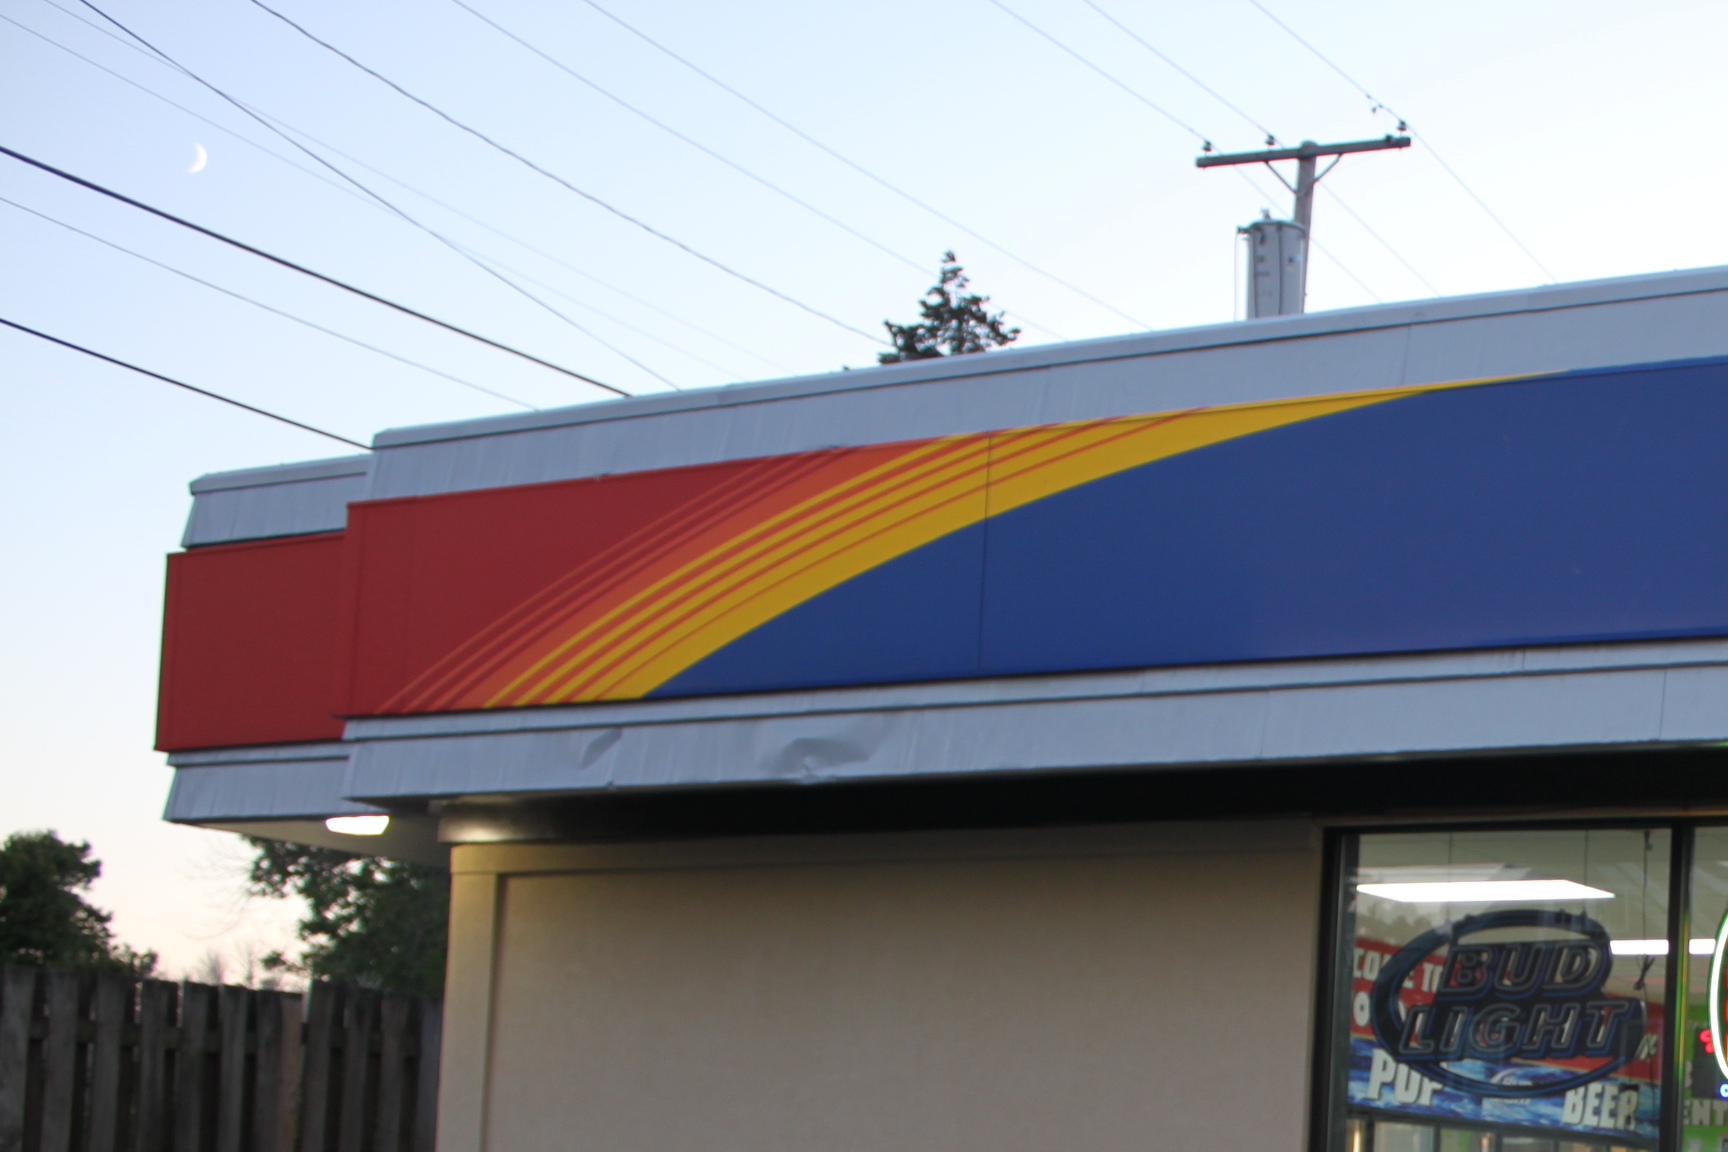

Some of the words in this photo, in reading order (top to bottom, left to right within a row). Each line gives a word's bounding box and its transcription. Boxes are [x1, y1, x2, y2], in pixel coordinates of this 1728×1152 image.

[1438, 943, 1603, 995] BUD
[1397, 1000, 1631, 1056] LIGHT
[1562, 1083, 1640, 1131] BEER
